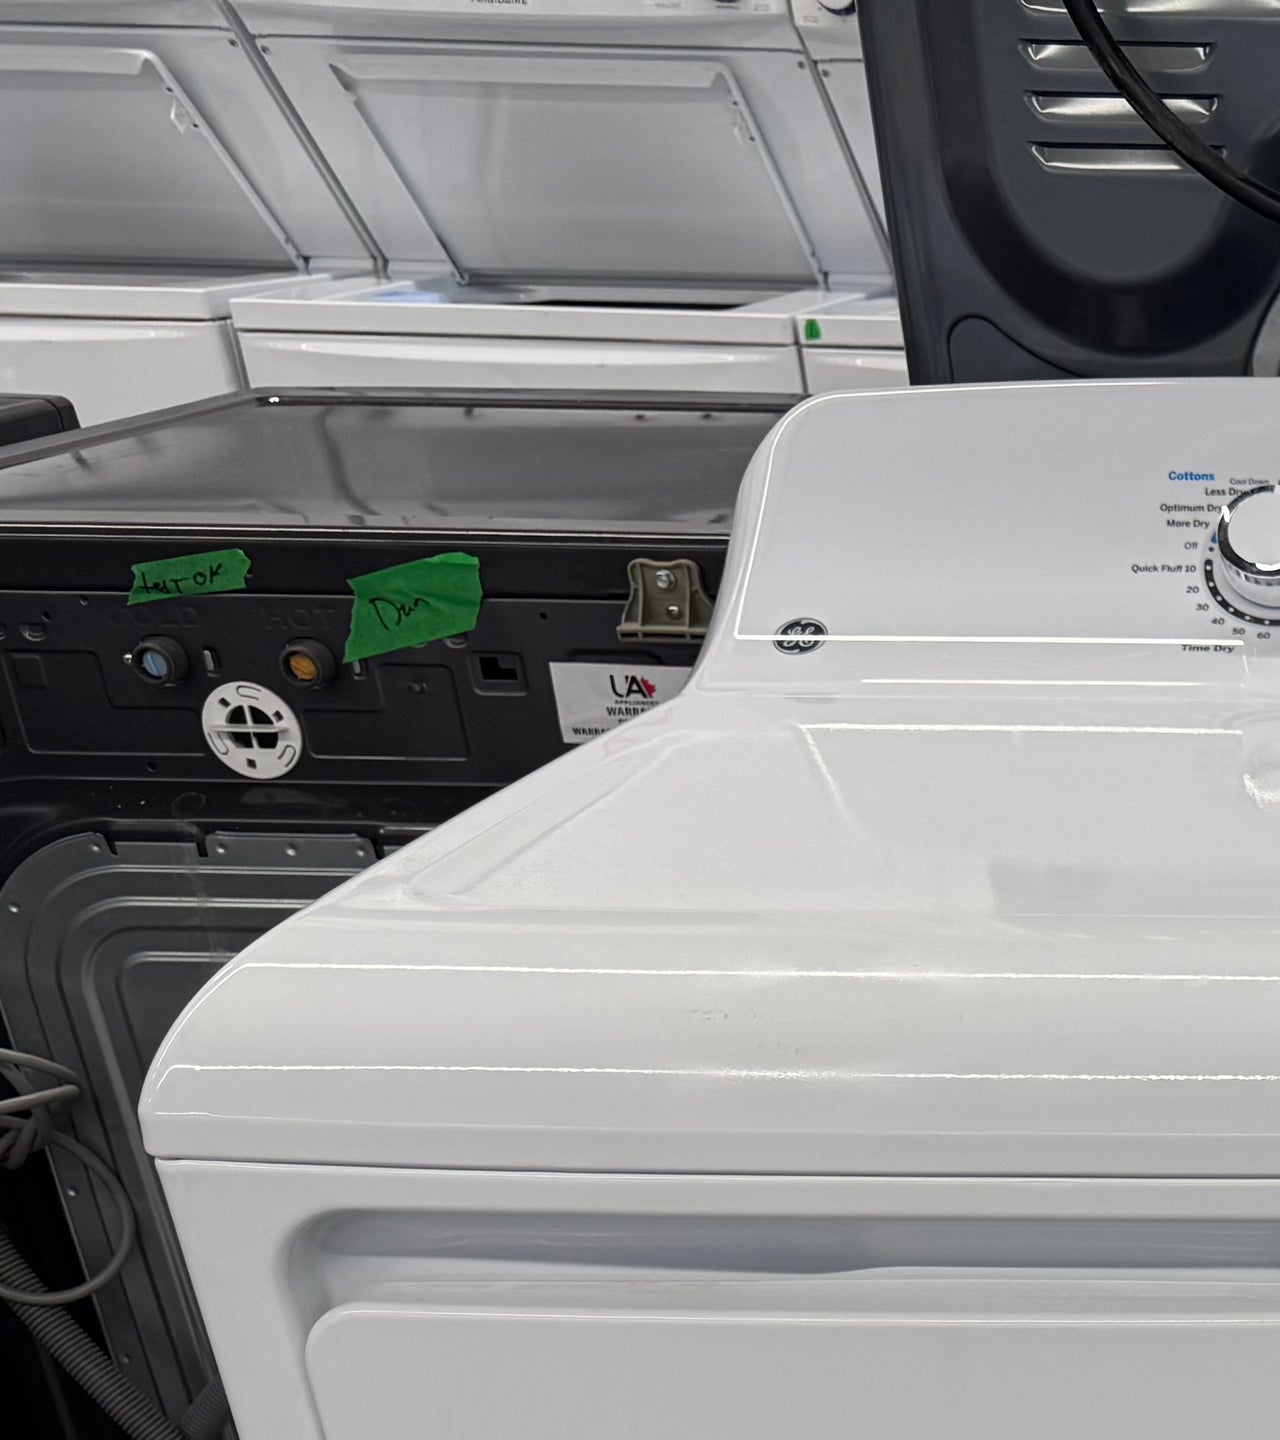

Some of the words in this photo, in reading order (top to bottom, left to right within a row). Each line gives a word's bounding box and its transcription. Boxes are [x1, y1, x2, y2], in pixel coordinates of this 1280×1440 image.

[1168, 470, 1215, 481] Cottons
[1205, 487, 1226, 496] Less
[1160, 503, 1205, 513] Optimum
[1207, 503, 1222, 513] Dry
[1167, 519, 1191, 528] More
[1193, 520, 1210, 529] Dry
[1184, 541, 1199, 550] Off
[1131, 564, 1159, 574] Quick
[1161, 564, 1182, 573] Fluff
[1185, 565, 1197, 573] 10
[1186, 586, 1200, 594] 20
[1195, 603, 1209, 612] 30
[1211, 618, 1225, 626] 40
[1232, 627, 1246, 636] 50
[1257, 632, 1271, 640] 60
[1181, 644, 1210, 652] Time
[1213, 644, 1235, 654] Dry
